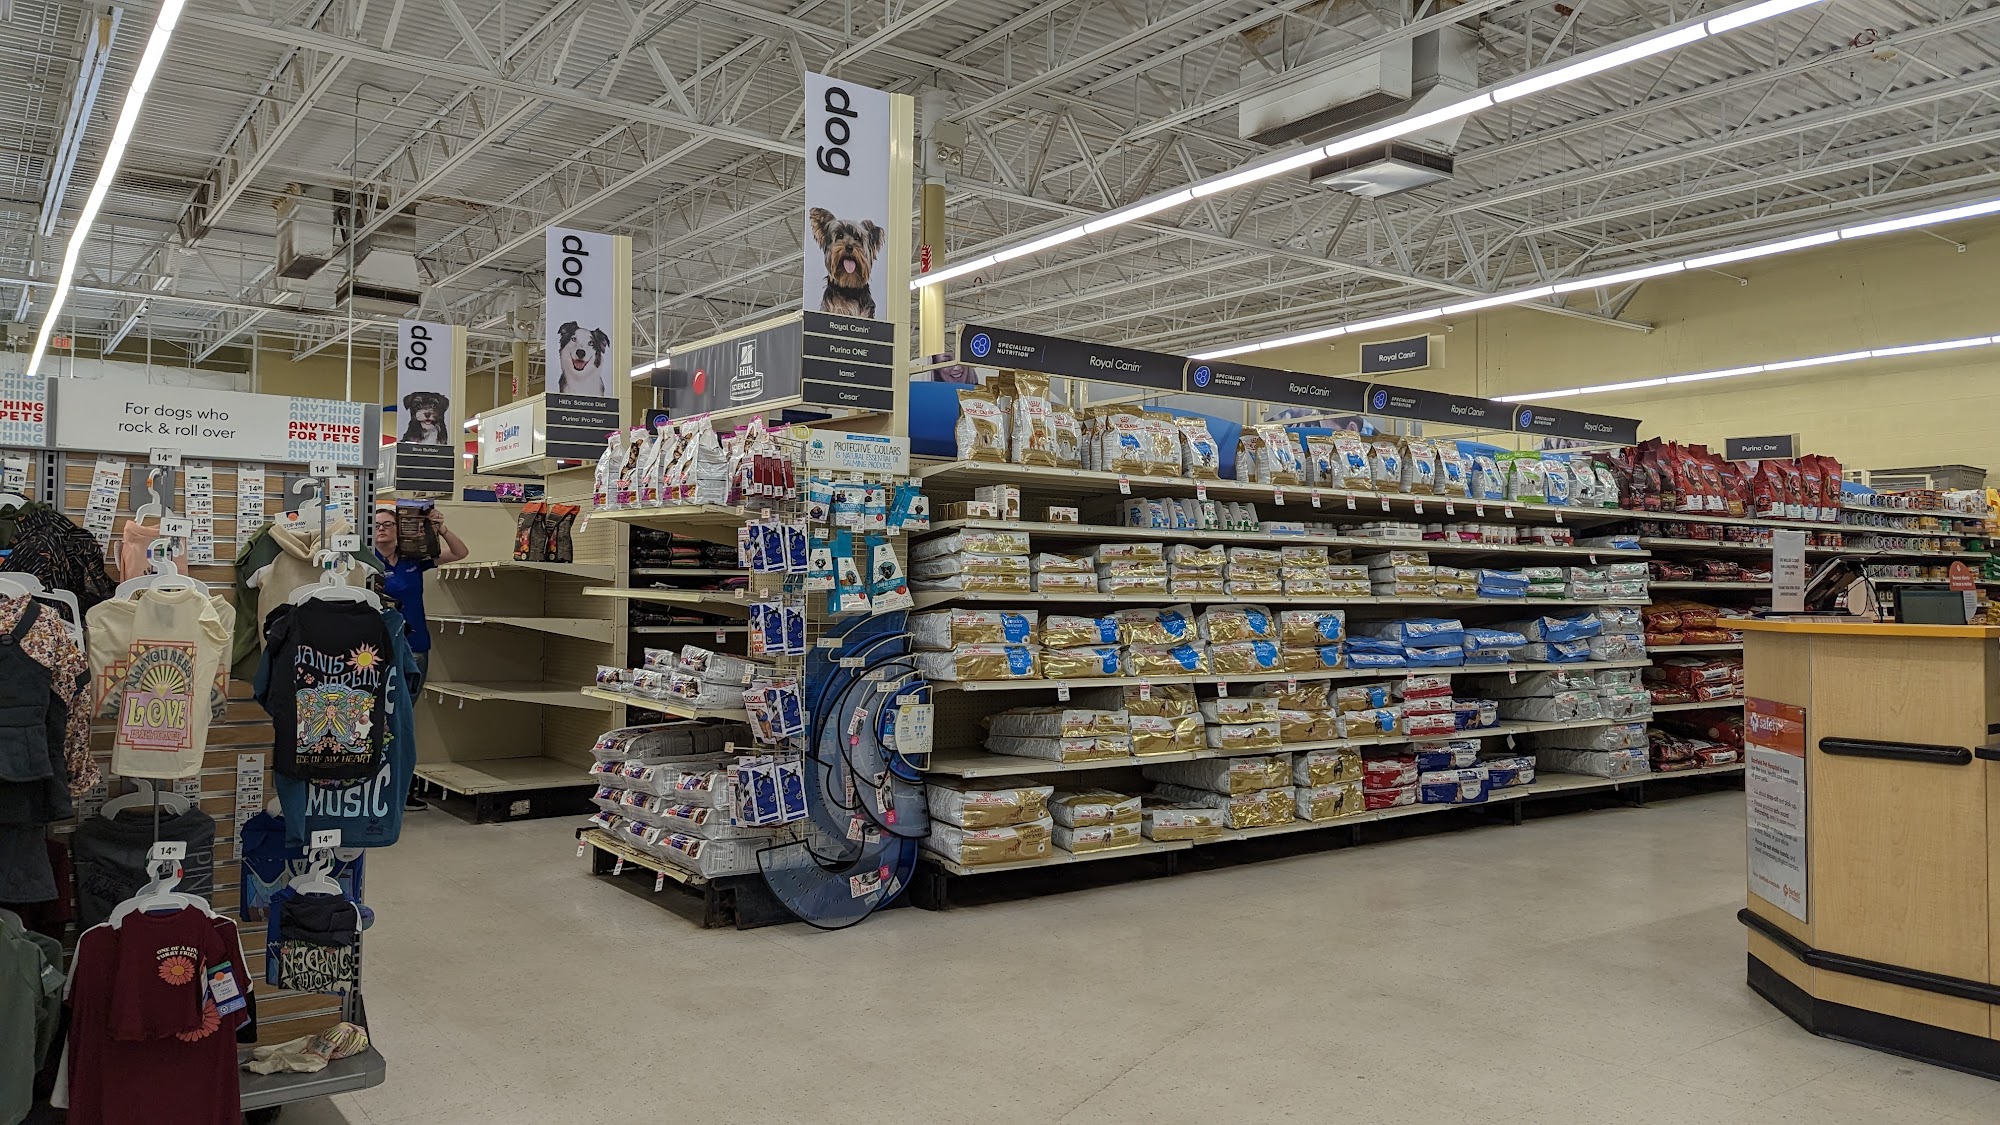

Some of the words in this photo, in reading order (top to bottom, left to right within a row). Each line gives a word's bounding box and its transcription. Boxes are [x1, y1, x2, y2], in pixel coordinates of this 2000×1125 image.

[817, 86, 858, 176] dog
[555, 235, 589, 298] dog
[829, 321, 849, 332] Royal
[850, 324, 869, 333] Canin
[405, 325, 432, 372] dog
[829, 345, 851, 355] Purina
[852, 348, 868, 357] ONE
[996, 348, 1029, 358] NUTRITION
[997, 342, 1035, 353] SPECIALIZED
[1378, 353, 1397, 362] Royal
[1397, 351, 1416, 360] Canin
[1090, 355, 1114, 370] Royal
[1115, 359, 1140, 372] Canin
[838, 369, 855, 378] Iams
[1215, 373, 1246, 382] SPECIALIZED
[1215, 378, 1241, 387] NUTRITION
[1289, 382, 1309, 395] Royal
[1309, 385, 1330, 397] Canin
[838, 392, 858, 401] Cesar
[125, 402, 150, 415] For
[154, 404, 192, 421] dogs
[197, 408, 229, 421] who
[290, 402, 361, 416] ANYTHING
[1450, 404, 1467, 416] Royal
[1467, 406, 1485, 417] Canin
[289, 411, 361, 425] ANYTHING
[118, 421, 153, 434] rock
[158, 422, 170, 434] &
[175, 424, 198, 436] roll
[202, 429, 236, 438] over
[288, 421, 361, 434] ANYTHING
[1584, 421, 1598, 432] Royal
[288, 431, 317, 441] FOR
[323, 433, 359, 443] PETS
[288, 440, 360, 452] ANYTHING
[834, 441, 871, 454] PROTECTIVE
[874, 444, 902, 456] COLLARS
[288, 450, 360, 461] ANYTHING
[842, 452, 864, 460] NATURAL
[294, 645, 345, 675] JANIS
[125, 697, 188, 730] LOVE
[342, 754, 372, 763] HEART
[305, 763, 391, 818] MUSIC
[156, 946, 170, 955] ONE
[281, 944, 352, 980] GARDEN
